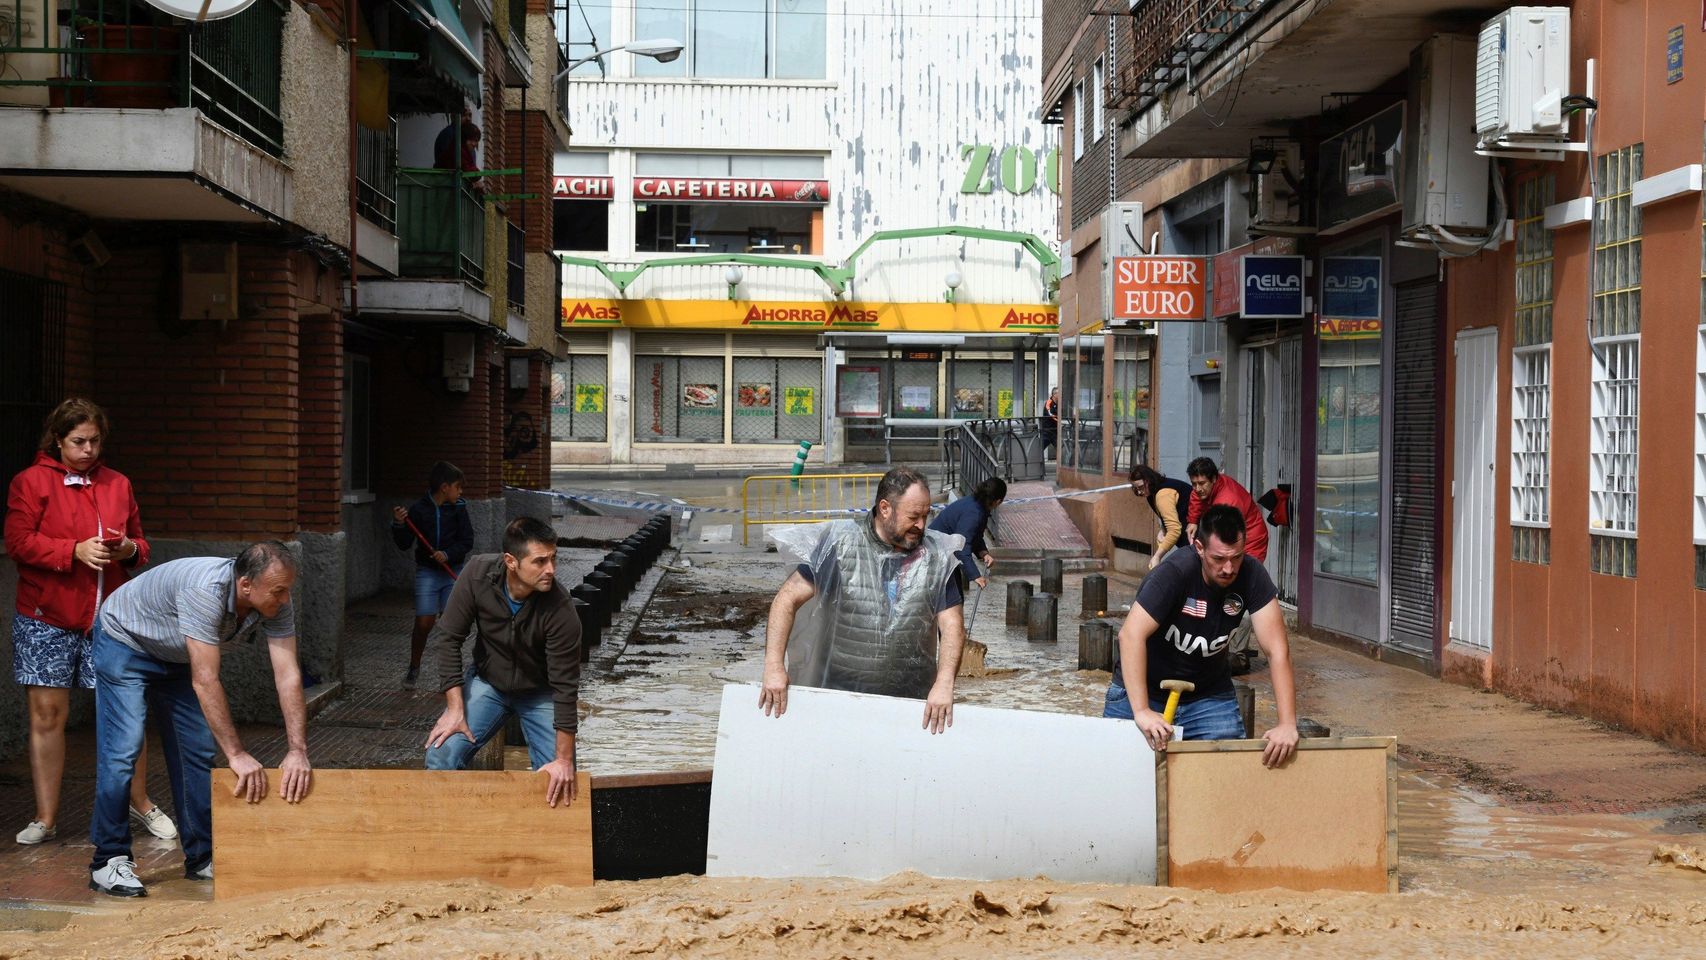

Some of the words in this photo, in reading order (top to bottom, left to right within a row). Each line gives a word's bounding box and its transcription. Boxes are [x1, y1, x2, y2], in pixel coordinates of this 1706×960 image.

[639, 179, 775, 198] CAFETERIA
[1119, 260, 1200, 284] SUPER
[1246, 274, 1300, 291] NEILA
[1125, 291, 1194, 314] EURO
